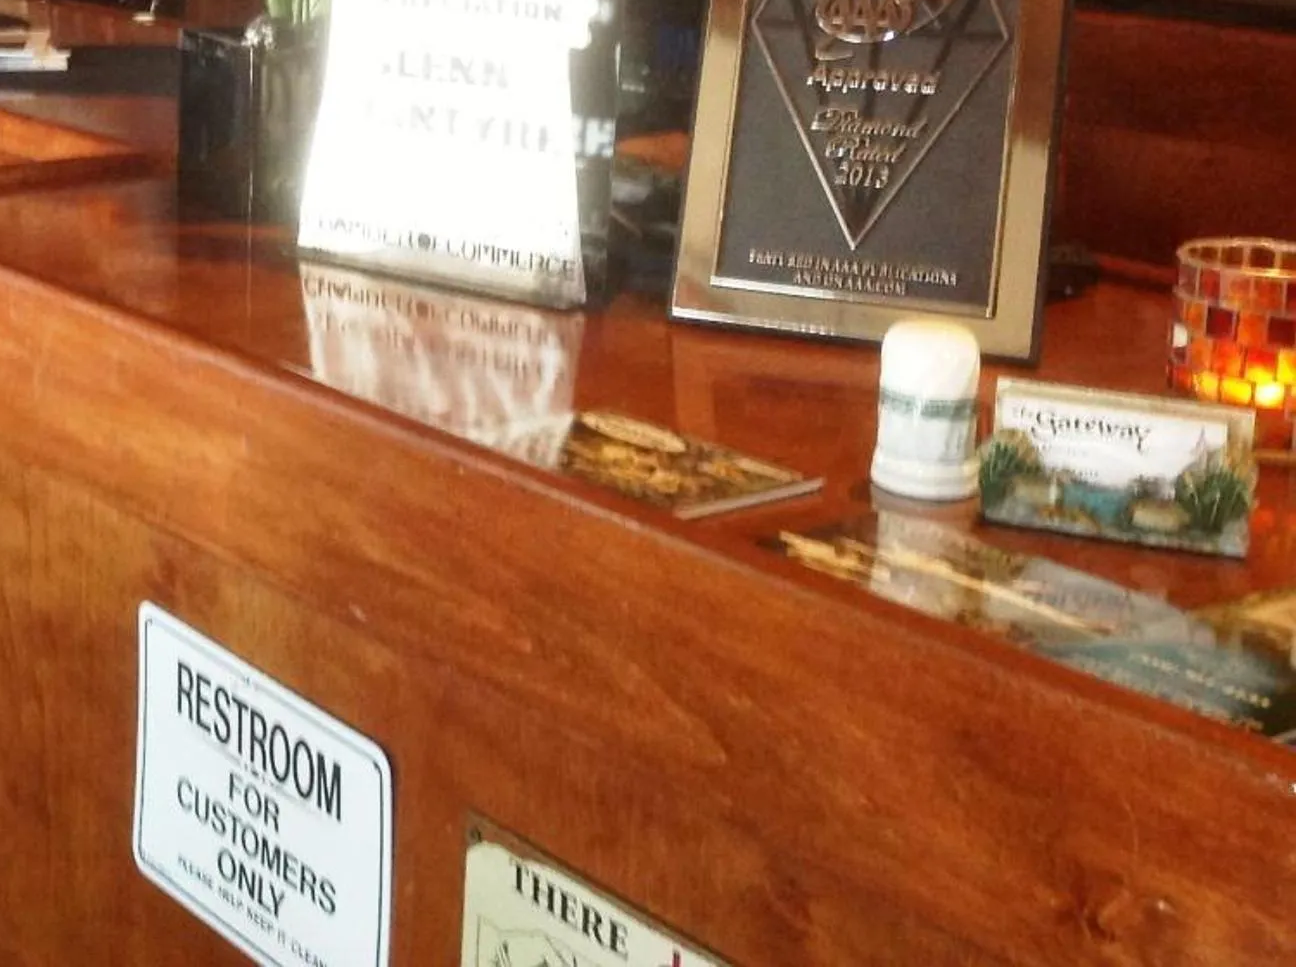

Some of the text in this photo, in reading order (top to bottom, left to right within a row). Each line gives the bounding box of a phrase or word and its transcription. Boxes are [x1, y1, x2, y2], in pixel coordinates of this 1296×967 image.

[807, 64, 940, 95] Approved
[811, 107, 927, 138] Diamond
[834, 161, 891, 189] 2013
[1031, 411, 1151, 453] Gateway
[177, 661, 342, 822] RESTROOM
[229, 772, 279, 832] FOR
[177, 776, 337, 916] CUSTOMERS
[178, 854, 213, 890] PLEASE
[246, 906, 274, 933] KEEP
[291, 937, 329, 967] CLEAN
[217, 847, 285, 919] ONLY
[508, 856, 629, 961] THERE
